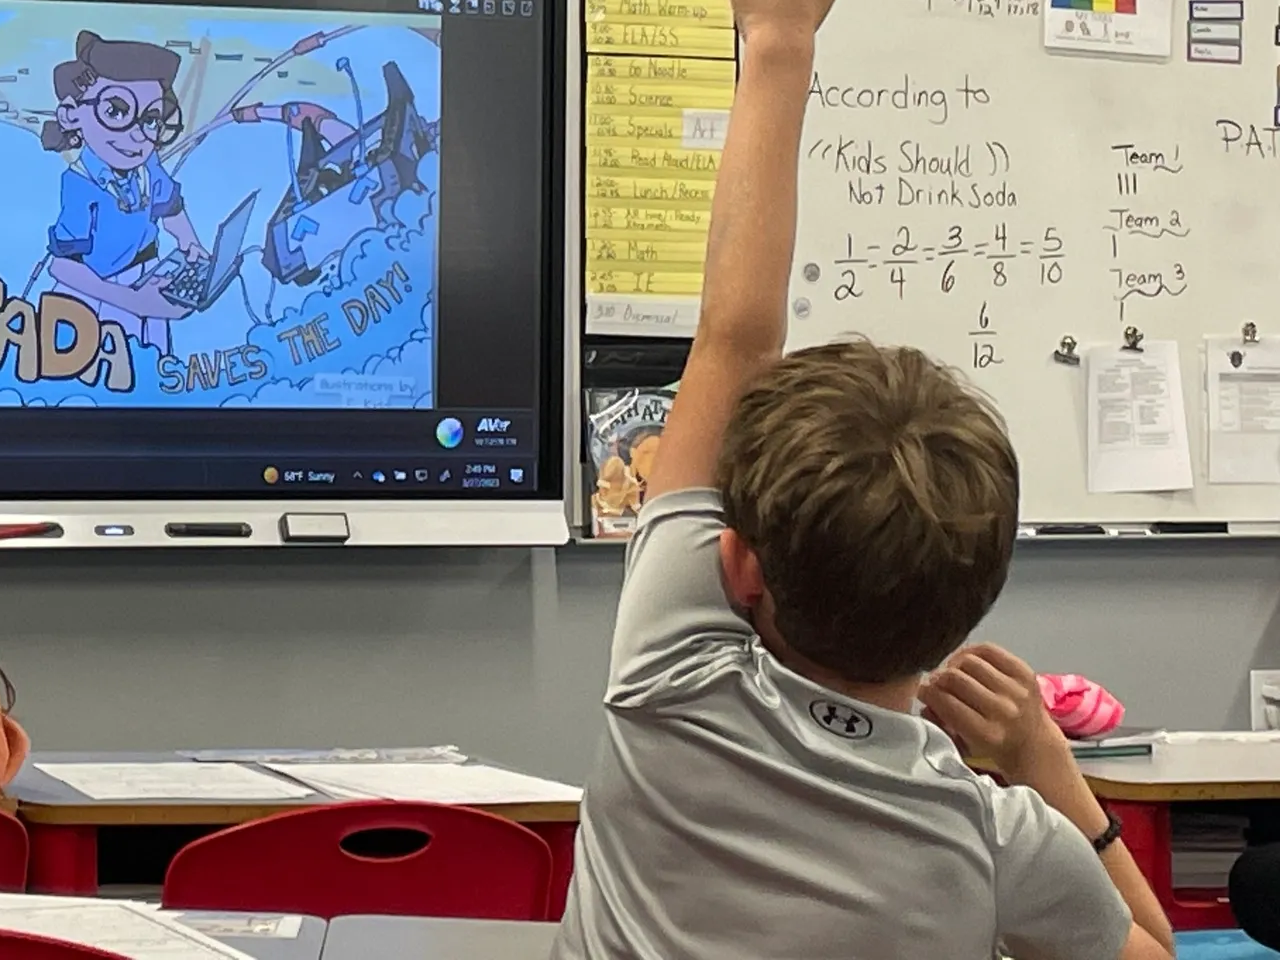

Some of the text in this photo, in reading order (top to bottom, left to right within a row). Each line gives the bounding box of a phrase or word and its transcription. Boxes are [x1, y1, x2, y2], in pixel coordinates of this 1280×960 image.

[809, 71, 990, 125] According to
[898, 140, 973, 178] Should
[1111, 144, 1165, 167] Team
[849, 176, 1018, 209] Not Drink Soda
[1109, 208, 1182, 229] Team 2
[1109, 263, 1186, 289] Team 3
[158, 261, 415, 394] SAVES THE DAY!
